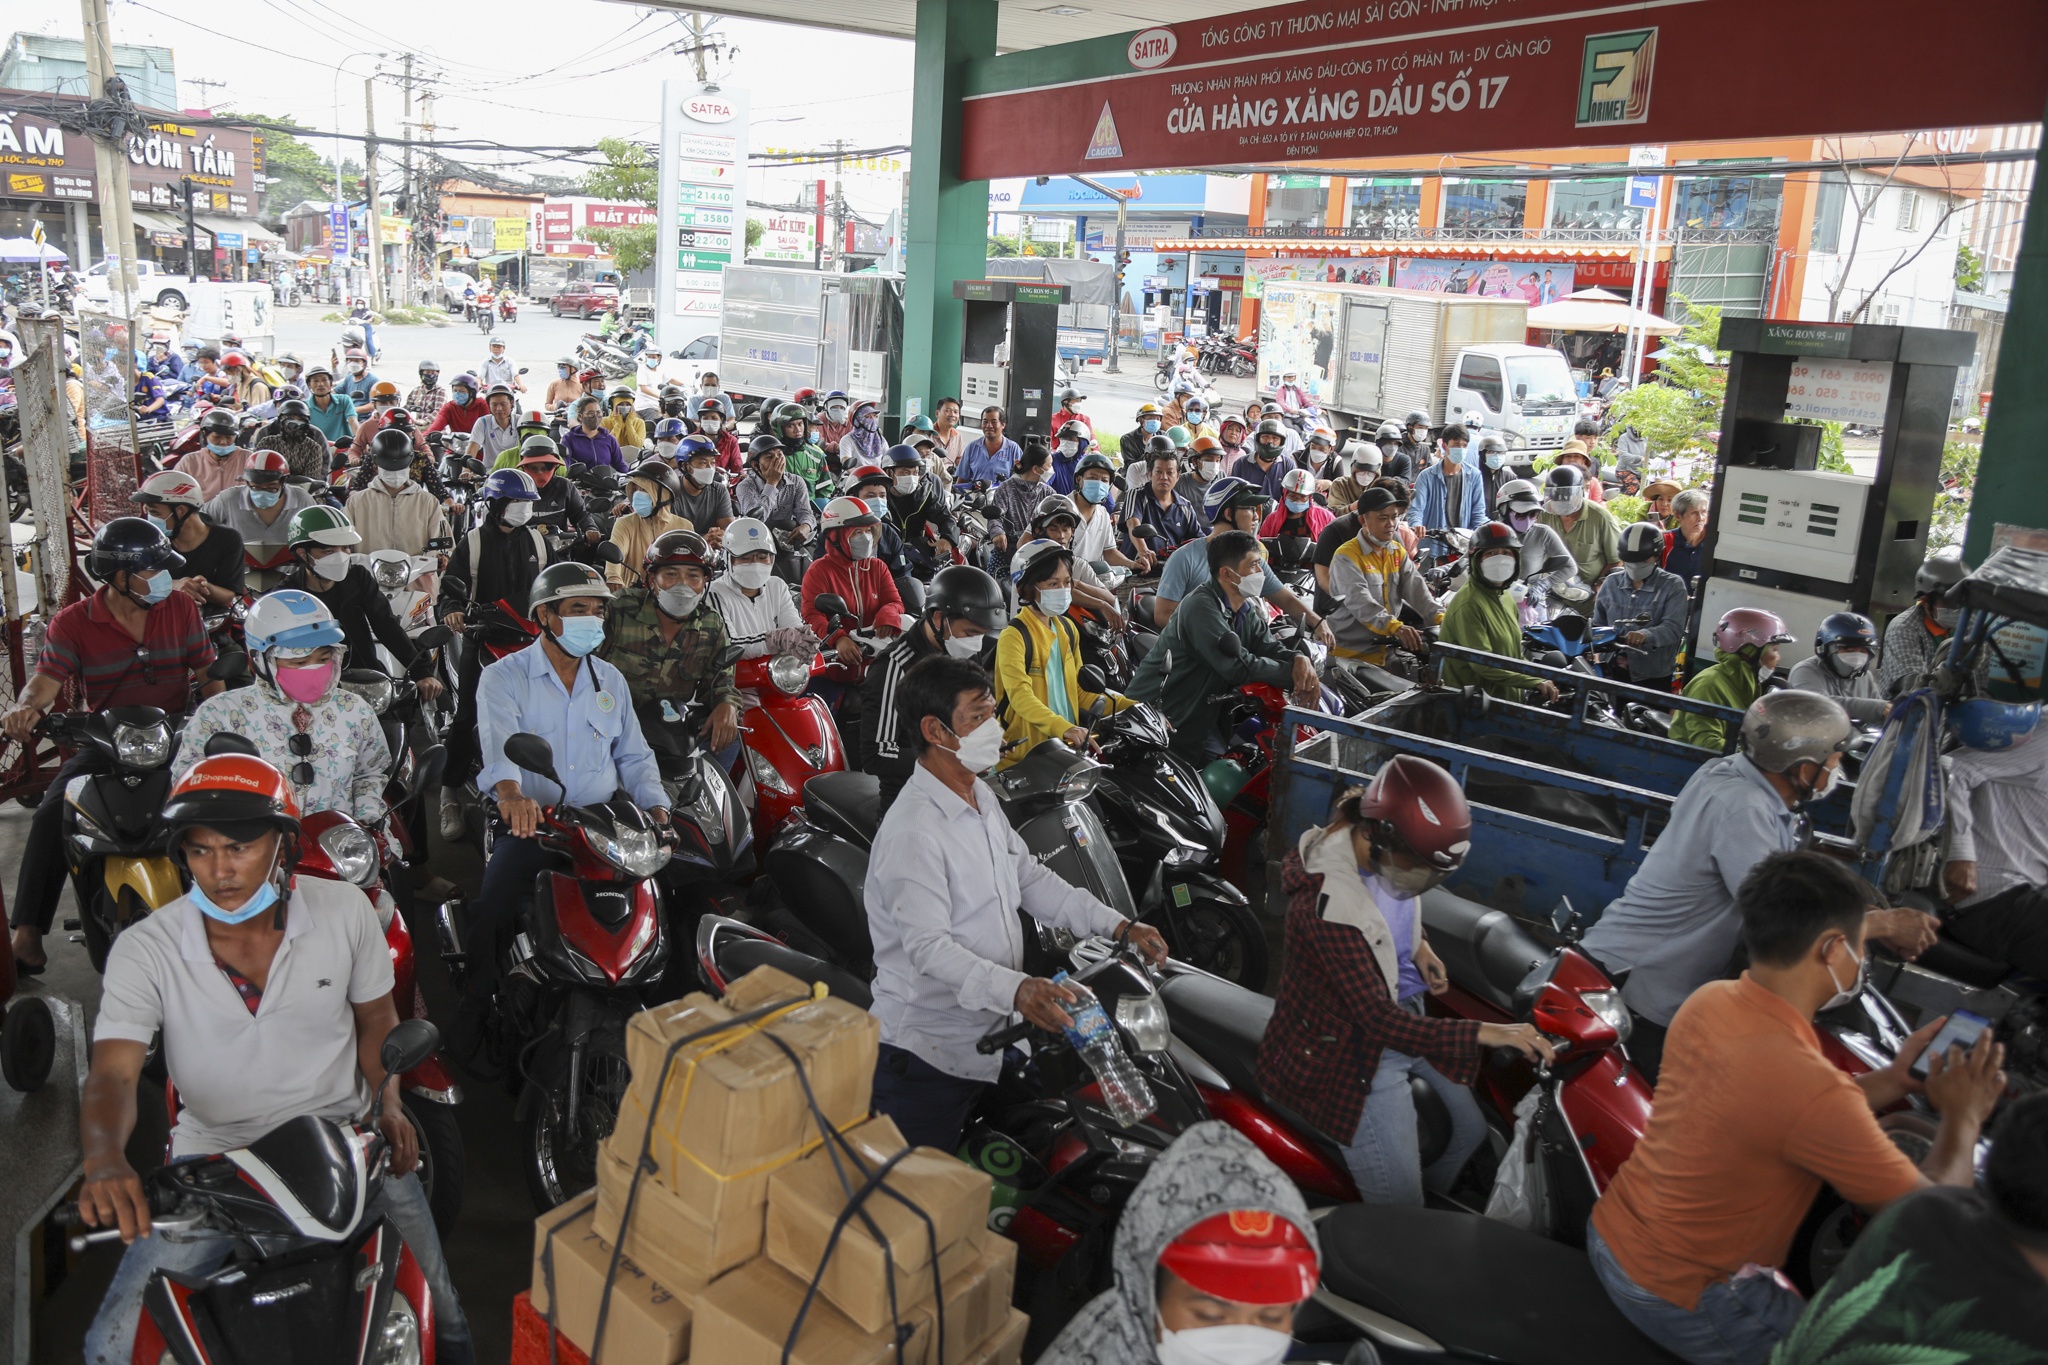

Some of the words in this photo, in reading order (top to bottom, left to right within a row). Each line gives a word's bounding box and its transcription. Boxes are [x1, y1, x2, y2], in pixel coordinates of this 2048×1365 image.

[1201, 25, 1229, 48] TỔNG
[1233, 22, 1265, 43] CÔNG
[1271, 20, 1283, 37] TY
[1336, 11, 1360, 29] MẠI
[1364, 1, 1384, 23] SÀI
[1134, 37, 1169, 60] SATRA
[1206, 76, 1231, 92] NHÂN
[1234, 72, 1258, 88] PHÂN
[1260, 66, 1281, 85] PHỐI
[1285, 65, 1313, 82] XĂNG
[1376, 59, 1389, 72] TY
[1412, 48, 1443, 68] PHẦN
[1449, 50, 1464, 64] TM
[1474, 46, 1490, 62] DV
[1495, 38, 1522, 59] CẦN
[1526, 36, 1552, 56] GIỜ
[1166, 96, 1206, 134] CỬA
[1211, 94, 1279, 131] HÀNG
[1282, 87, 1360, 125] XĂNG
[1367, 73, 1424, 118] DẦU
[1429, 66, 1473, 113] SỐ
[1478, 76, 1510, 110] 17
[690, 102, 731, 117] SATRA
[1262, 134, 1272, 143] 652
[1319, 127, 1342, 140] CHÁNH
[189, 133, 236, 177] TẤM
[1091, 146, 1118, 157] CAGICO
[697, 190, 730, 202] 21440
[594, 207, 624, 224] MẮT
[768, 215, 787, 231] MẮT
[789, 217, 806, 233] KÍNH
[1768, 327, 1794, 339] XĂNG
[1795, 329, 1816, 340] RON
[1816, 331, 1826, 339] 95
[1834, 332, 1845, 341] III
[595, 891, 626, 899] HONDA
[532, 960, 550, 980] HONDA
